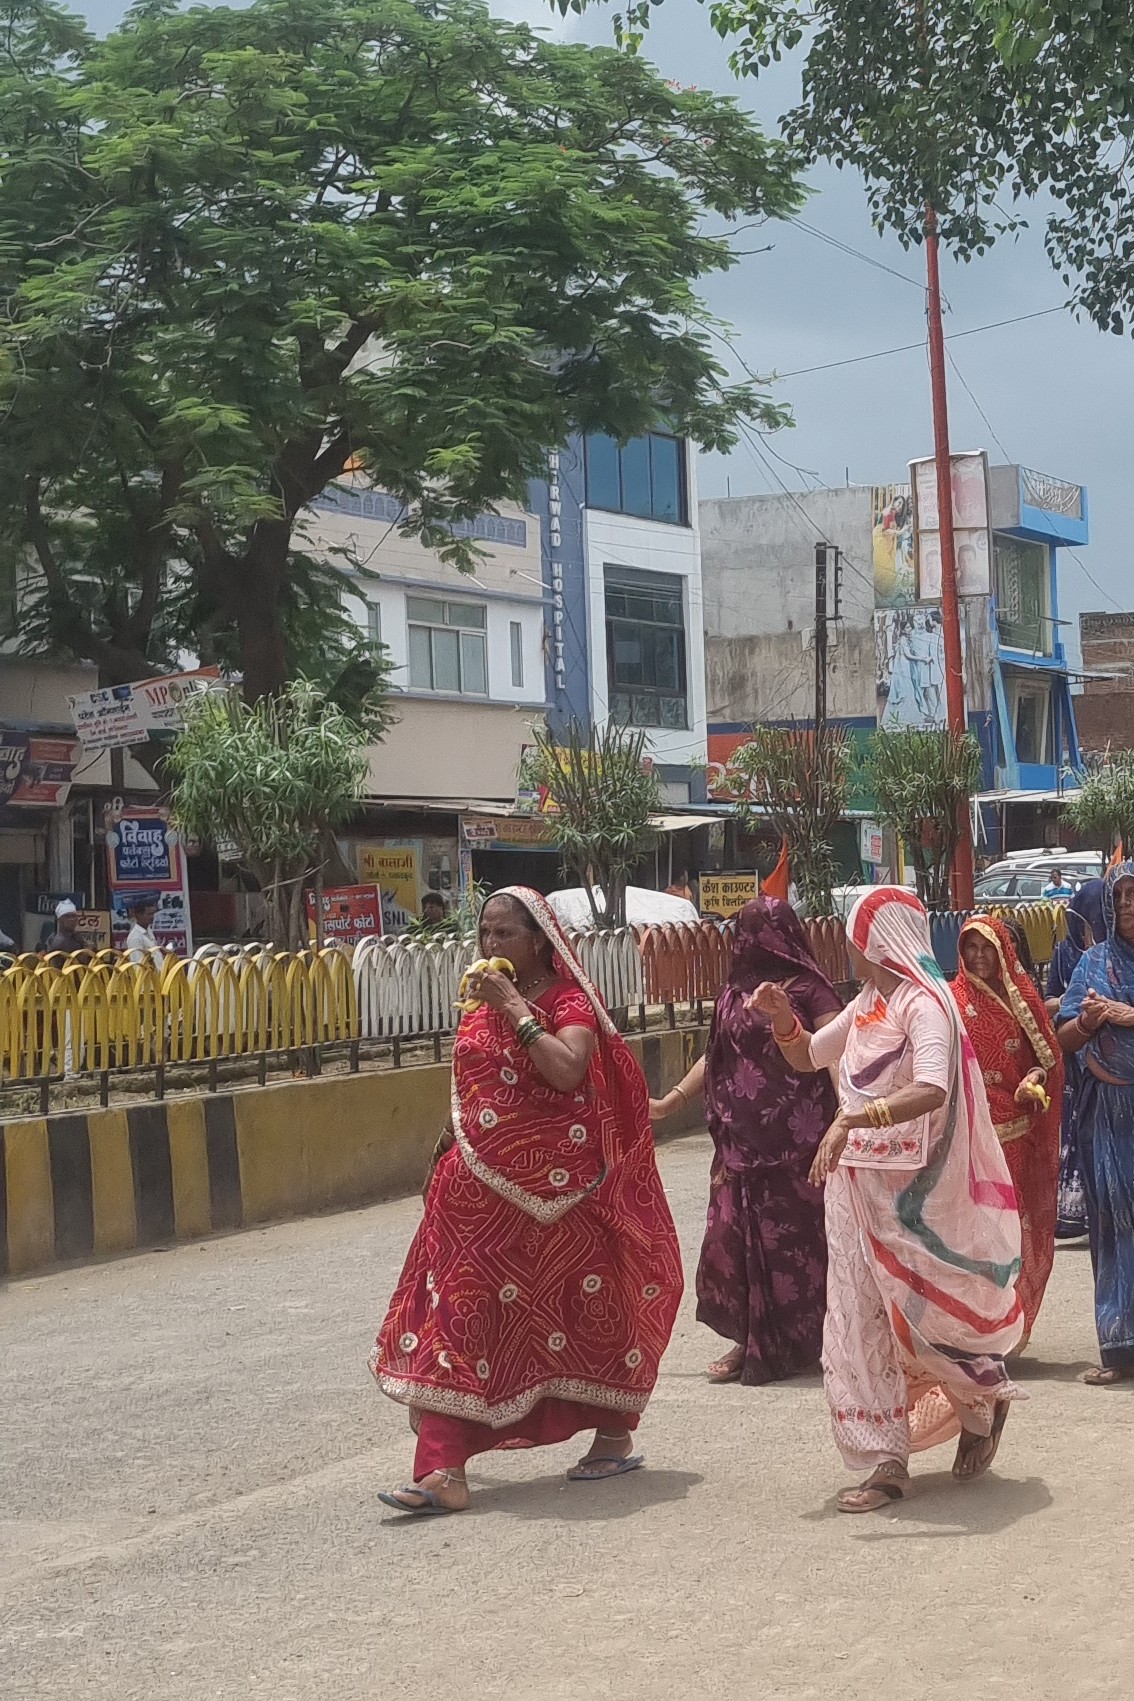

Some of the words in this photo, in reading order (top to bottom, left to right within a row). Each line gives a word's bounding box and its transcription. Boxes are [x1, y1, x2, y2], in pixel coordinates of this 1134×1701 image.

[548, 448, 561, 547] HIRWAD
[553, 563, 565, 689] HOSPITAL
[119, 820, 164, 857] विवाह
[722, 895, 752, 907] क्लिनि
[353, 913, 375, 928] फोटो
[384, 911, 408, 925] SNL
